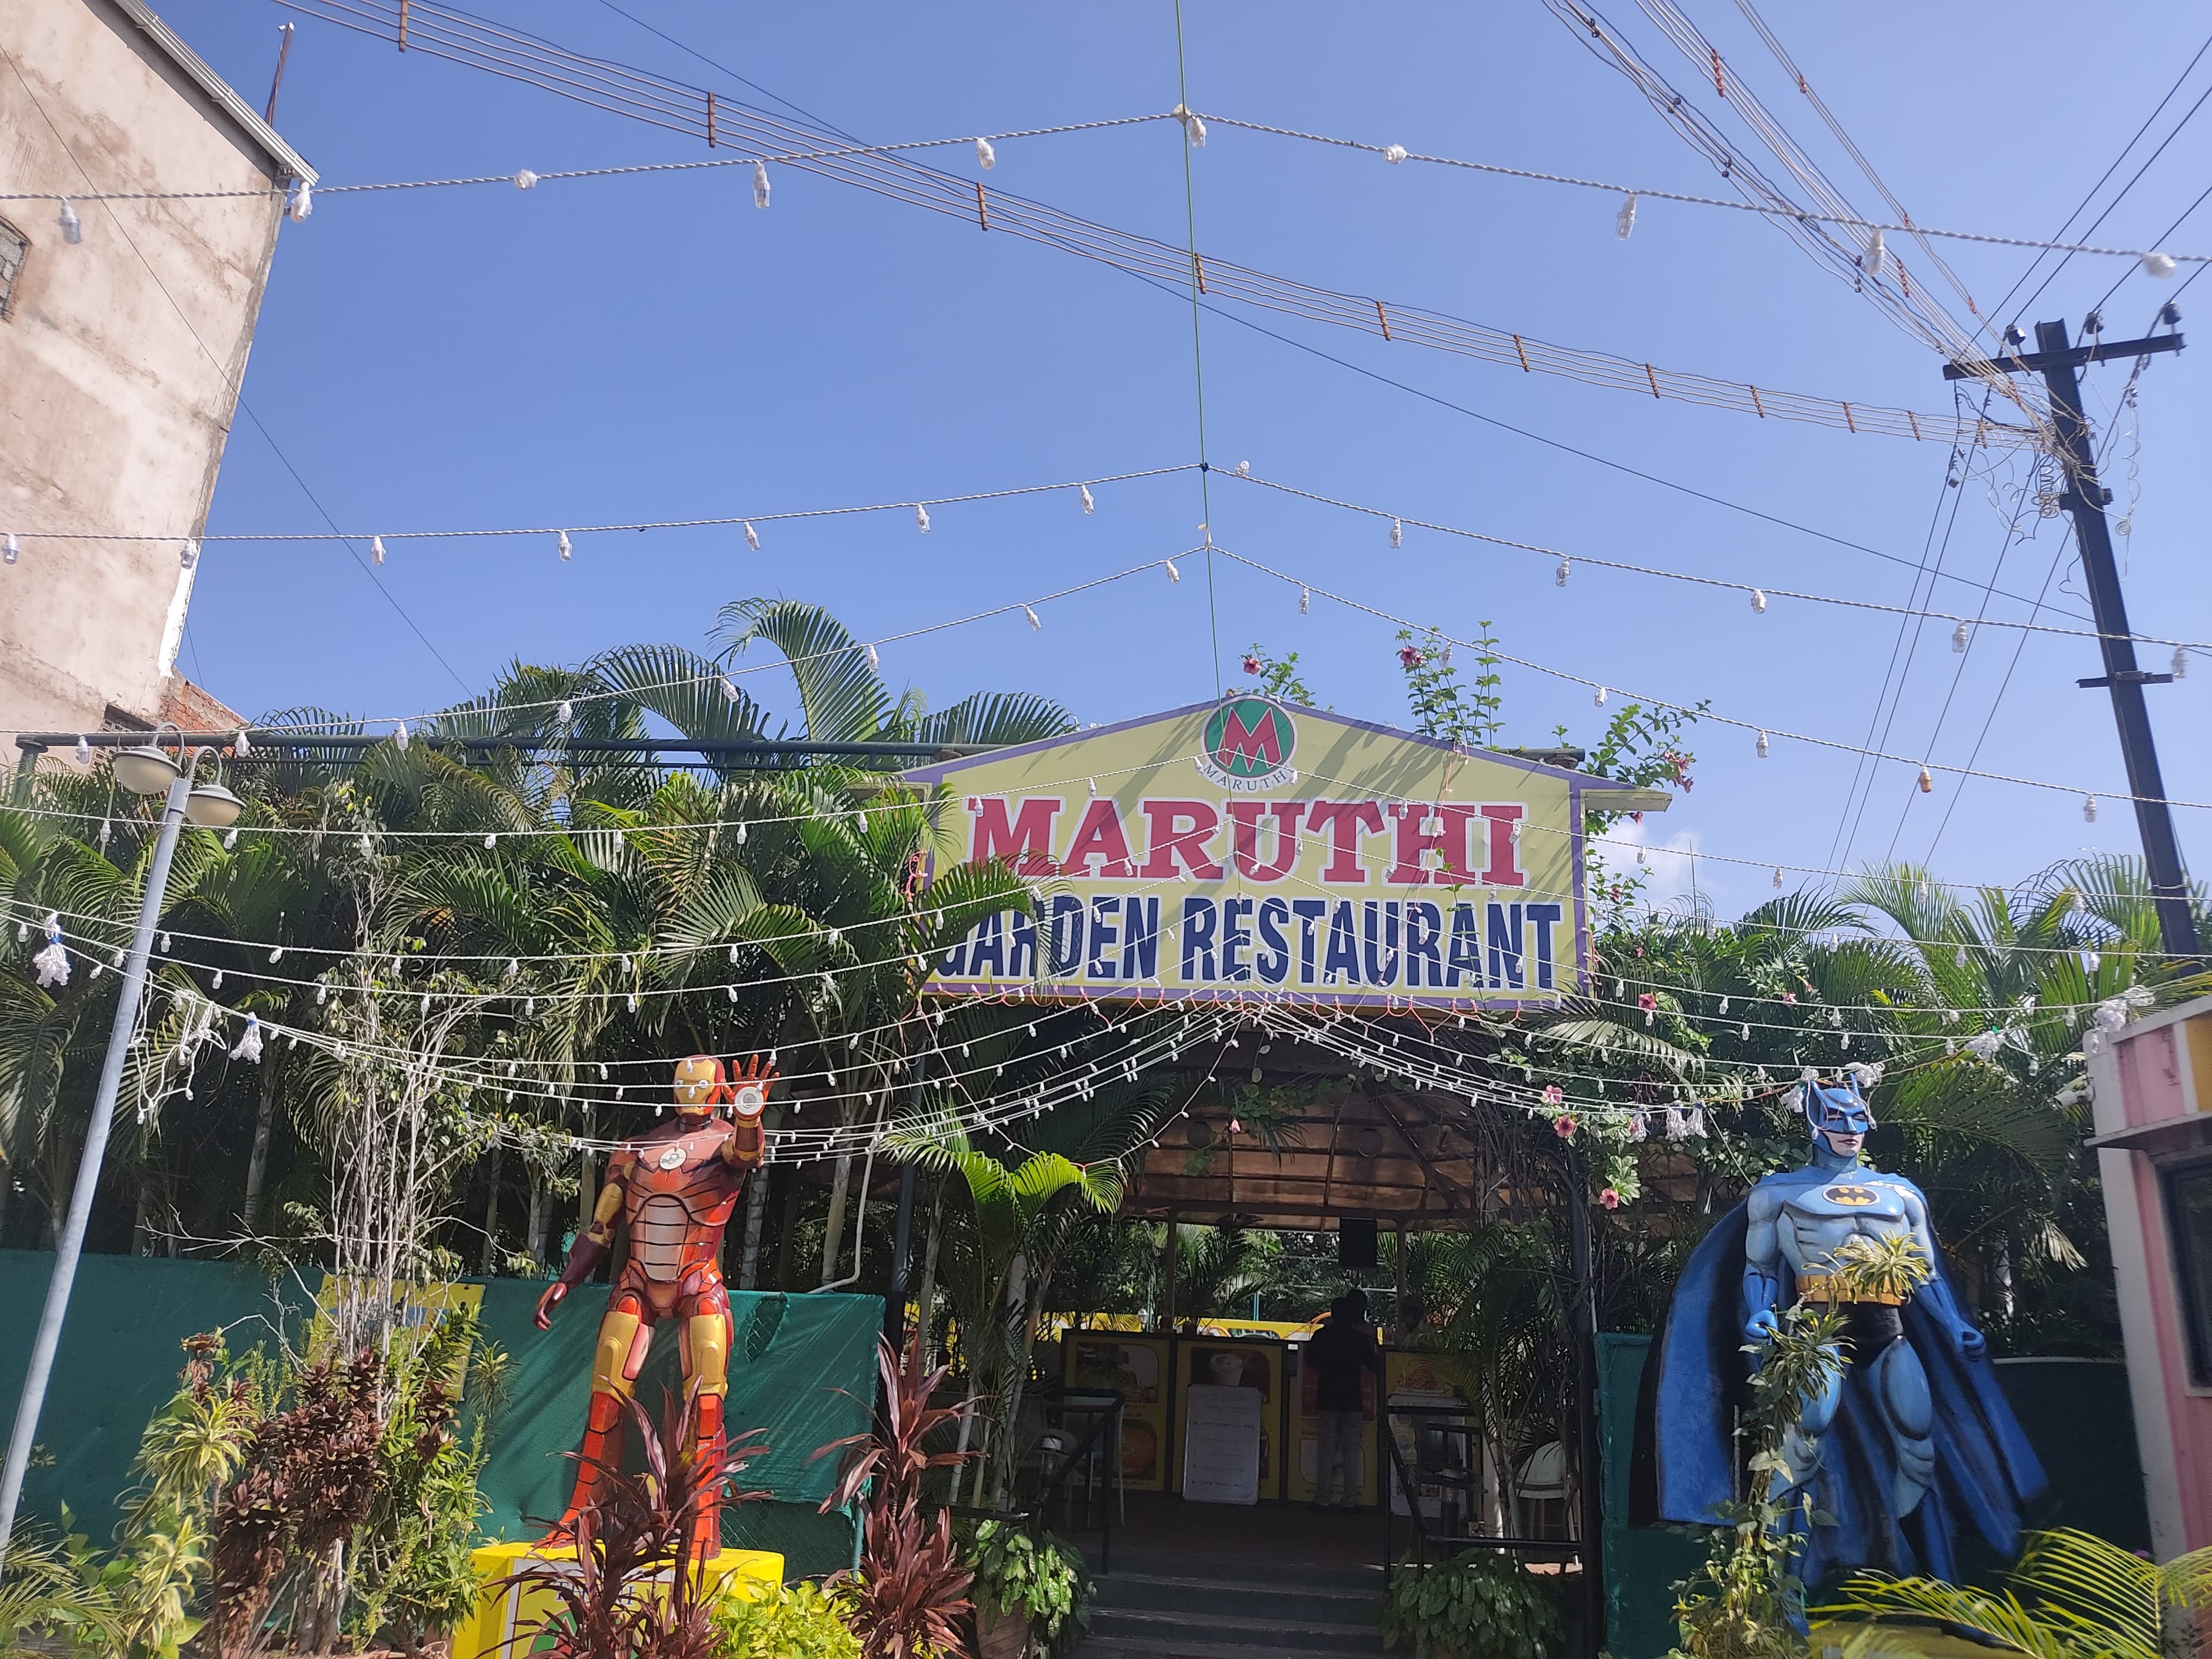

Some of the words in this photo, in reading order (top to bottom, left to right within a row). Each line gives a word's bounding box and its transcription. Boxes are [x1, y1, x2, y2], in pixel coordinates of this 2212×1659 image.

[1216, 707, 1282, 773] M
[965, 798, 1524, 886] MARUTHI
[1182, 896, 1561, 990] RESTAURANT
